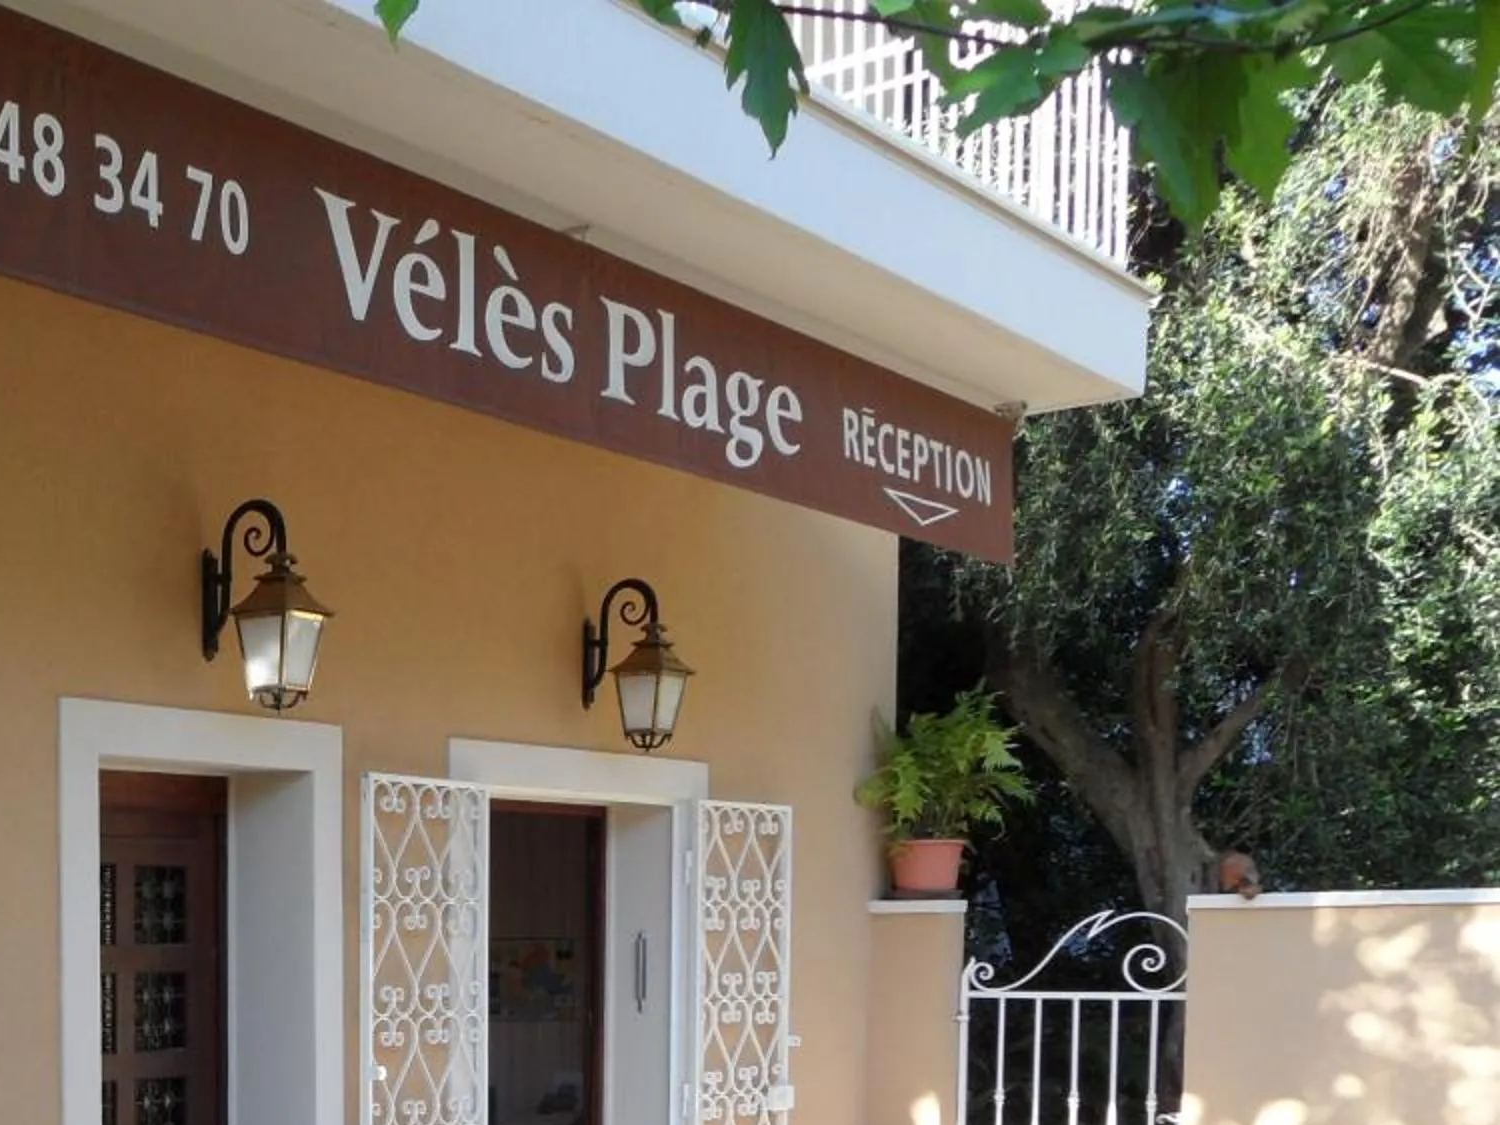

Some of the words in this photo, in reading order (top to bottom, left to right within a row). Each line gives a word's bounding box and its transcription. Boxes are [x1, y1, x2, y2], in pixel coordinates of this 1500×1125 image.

[94, 134, 163, 228] 34
[187, 165, 249, 255] 70
[315, 187, 575, 384] Vélès
[600, 296, 803, 469] Plage
